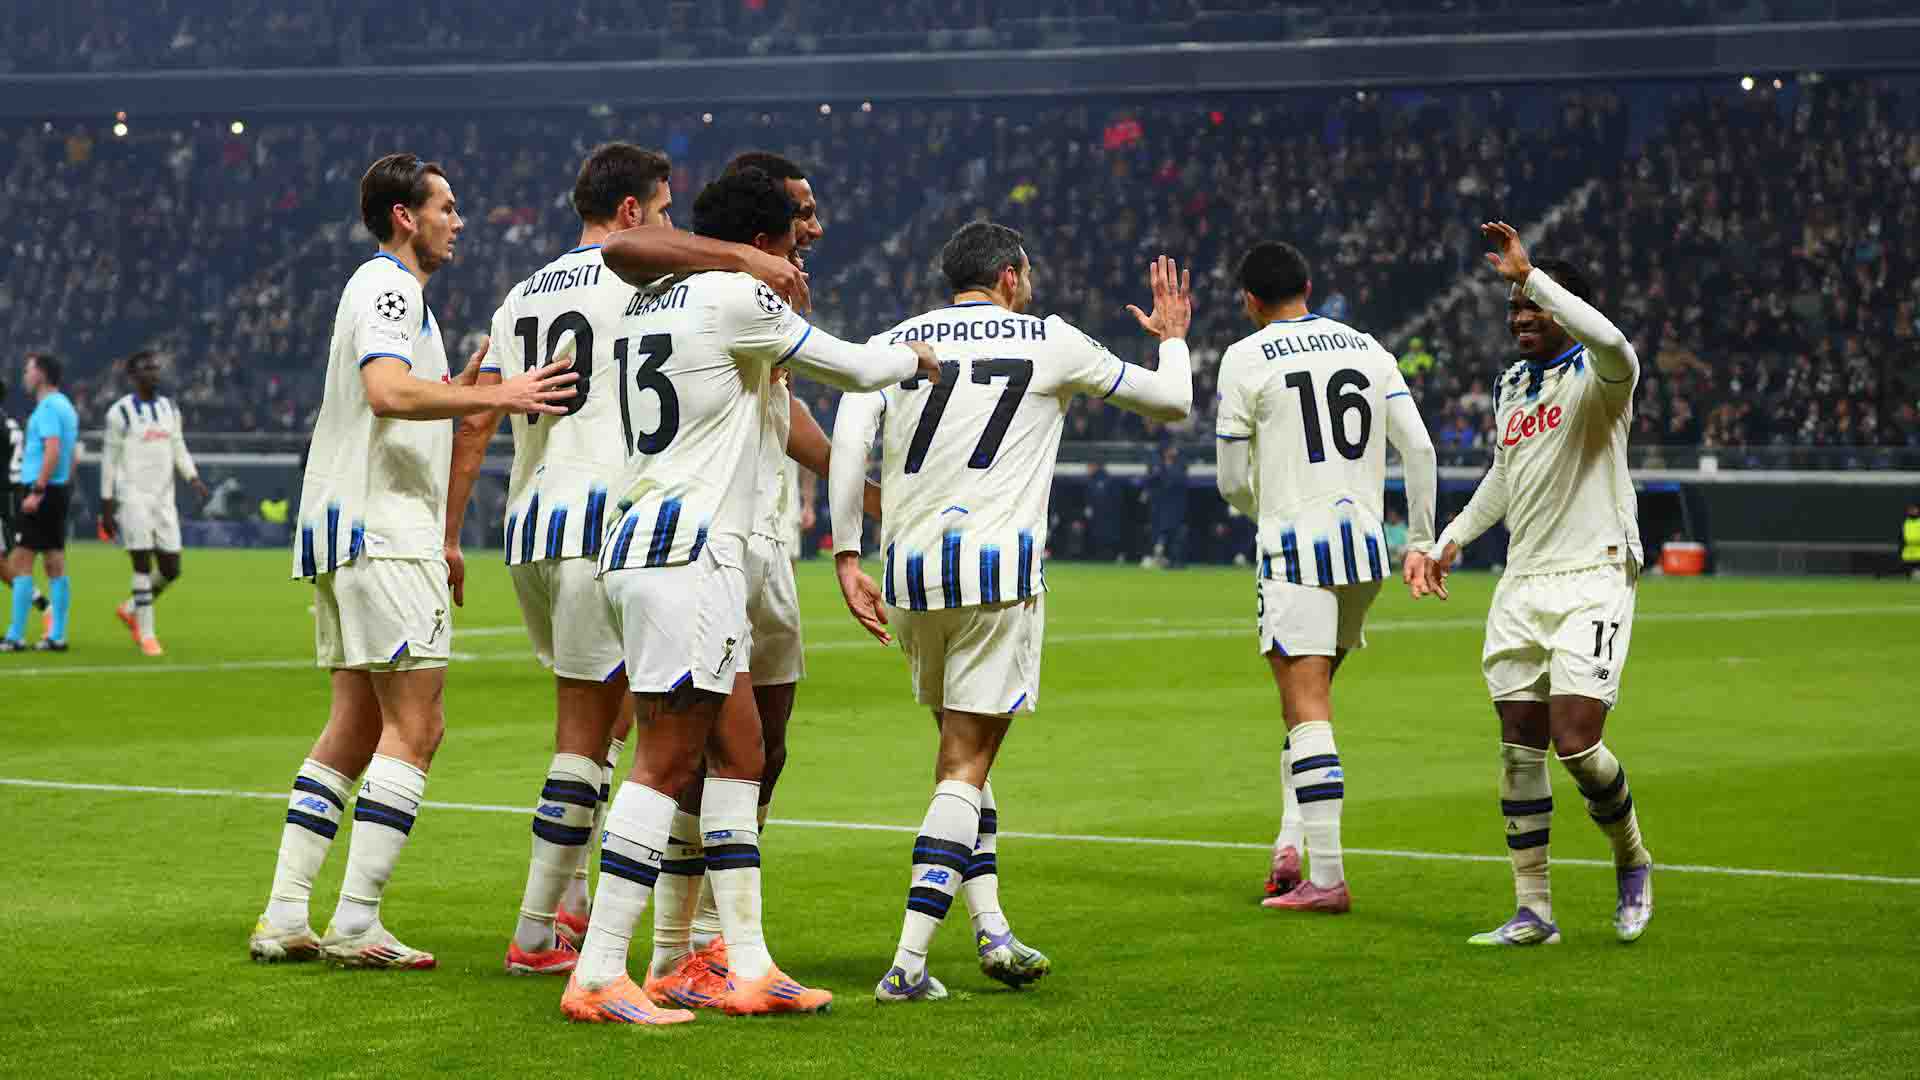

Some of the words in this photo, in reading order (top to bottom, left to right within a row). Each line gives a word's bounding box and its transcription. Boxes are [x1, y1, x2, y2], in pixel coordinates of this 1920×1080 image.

[522, 264, 602, 297] DJIMSITI
[888, 318, 1047, 346] ZAPPACOSTA
[1261, 333, 1369, 361] BELLANOVA
[613, 333, 680, 457] 13
[900, 358, 1034, 475] 77
[1285, 368, 1373, 465] 16
[1503, 403, 1562, 447] Lete
